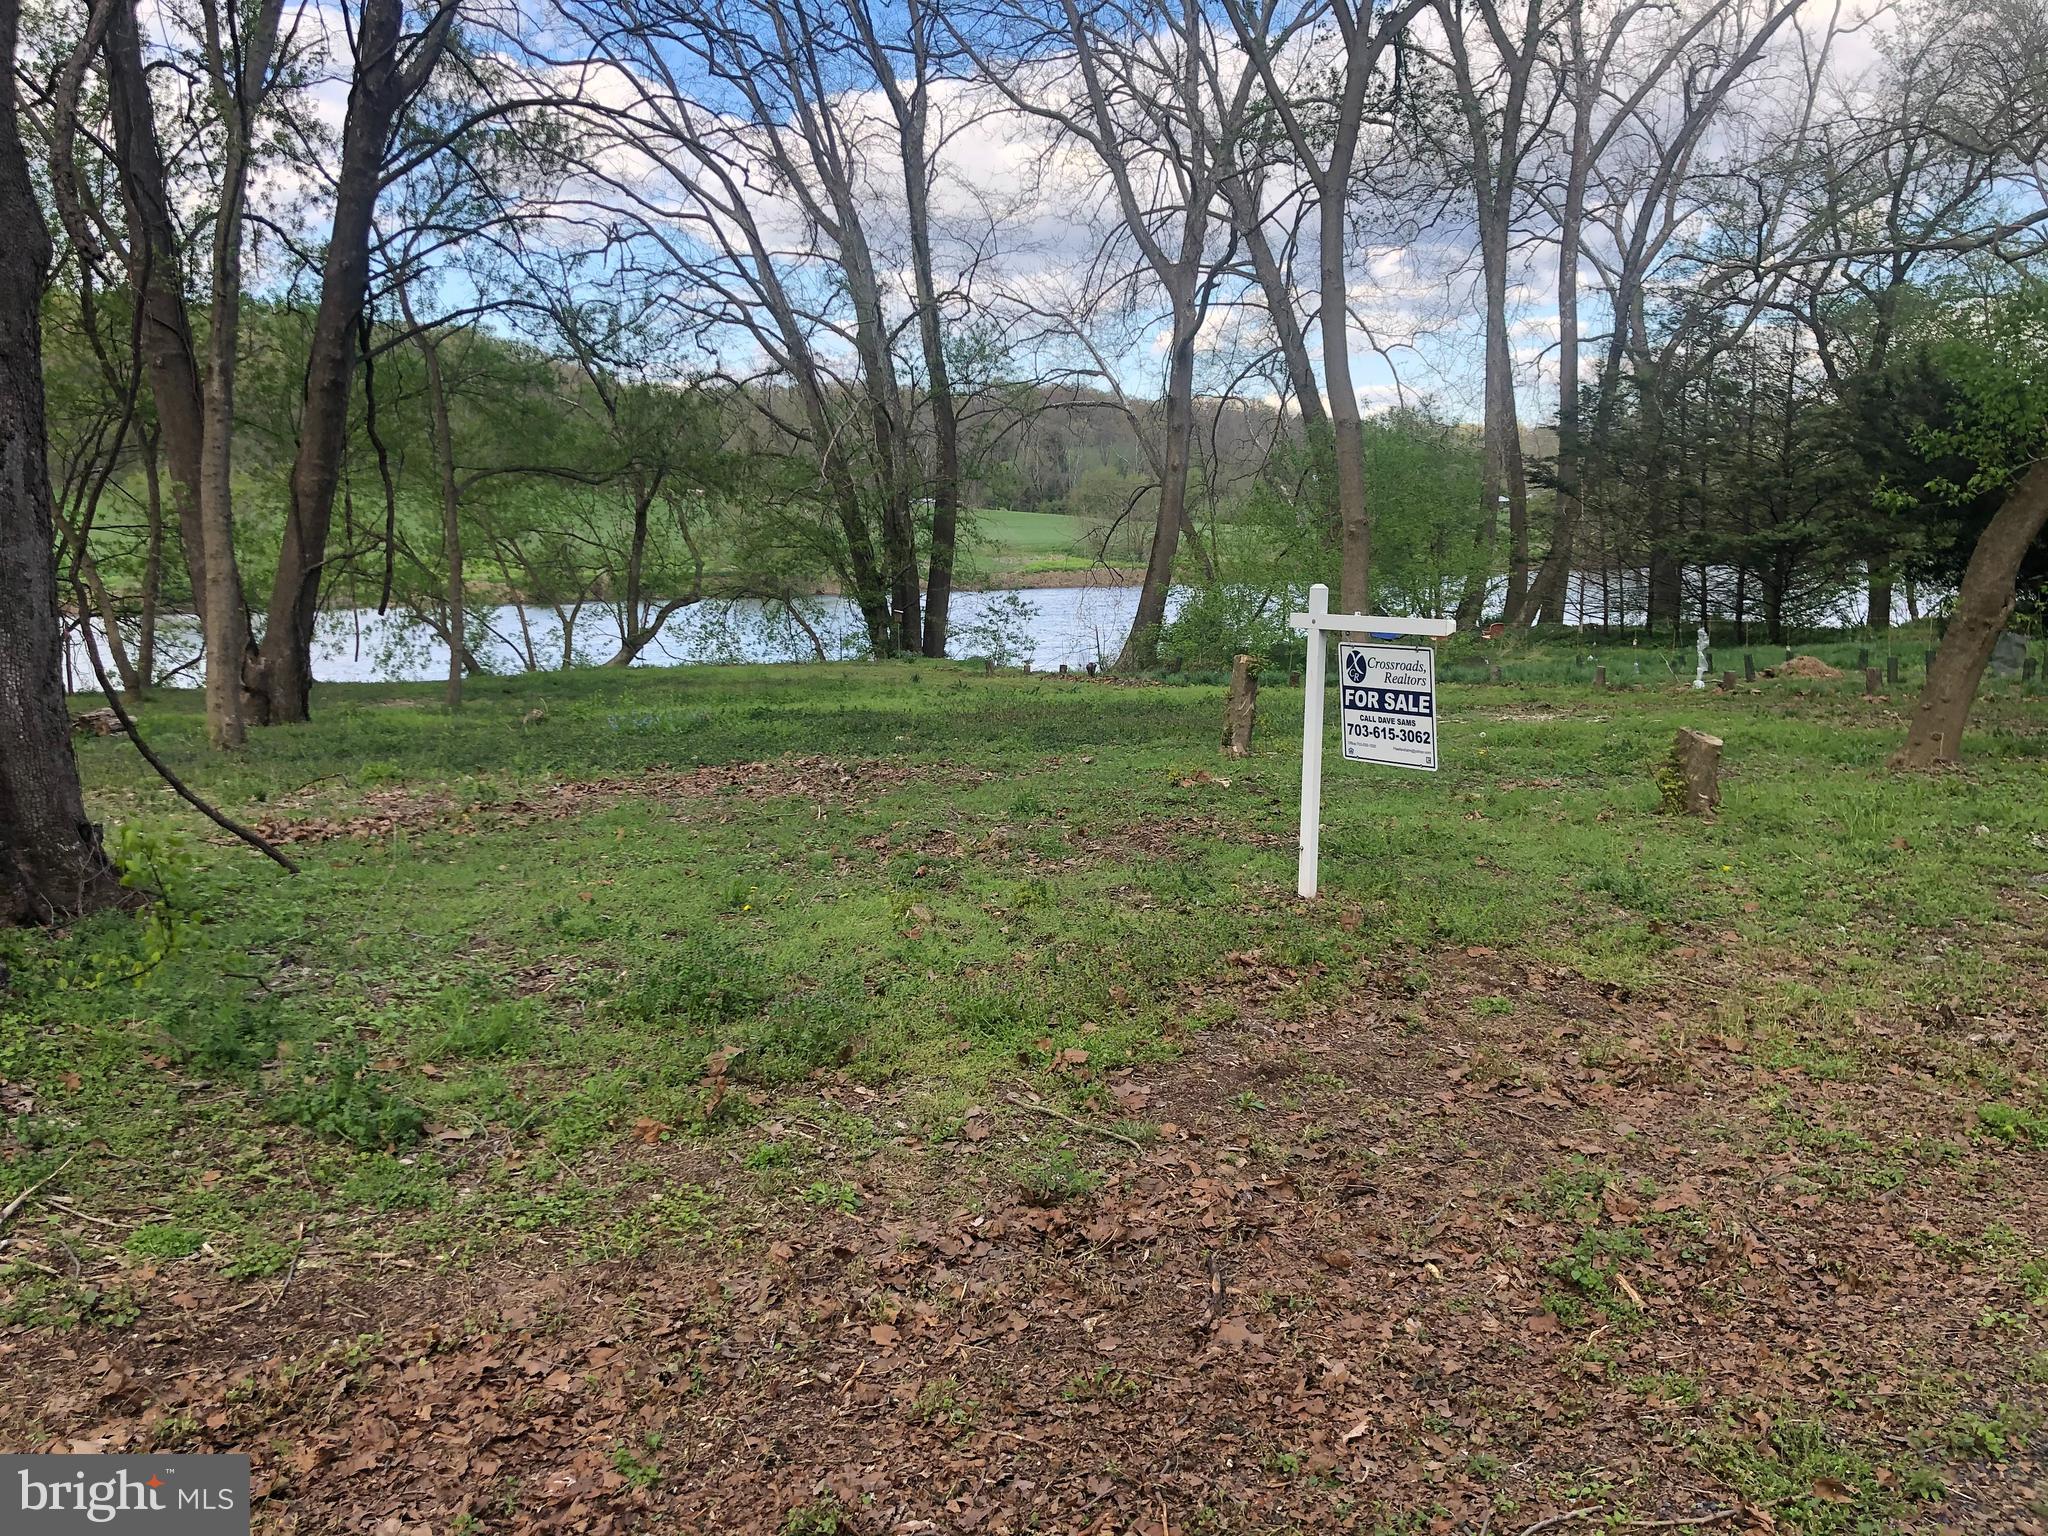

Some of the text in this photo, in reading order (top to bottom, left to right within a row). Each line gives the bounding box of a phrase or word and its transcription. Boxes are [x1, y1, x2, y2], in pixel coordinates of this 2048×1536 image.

[1367, 657, 1427, 673] Crossroads,
[1384, 672, 1427, 686] Realtors
[1345, 689, 1430, 713] FOR SALE
[1360, 715, 1377, 723] CALL
[1347, 723, 1431, 744] 703-615-3062
